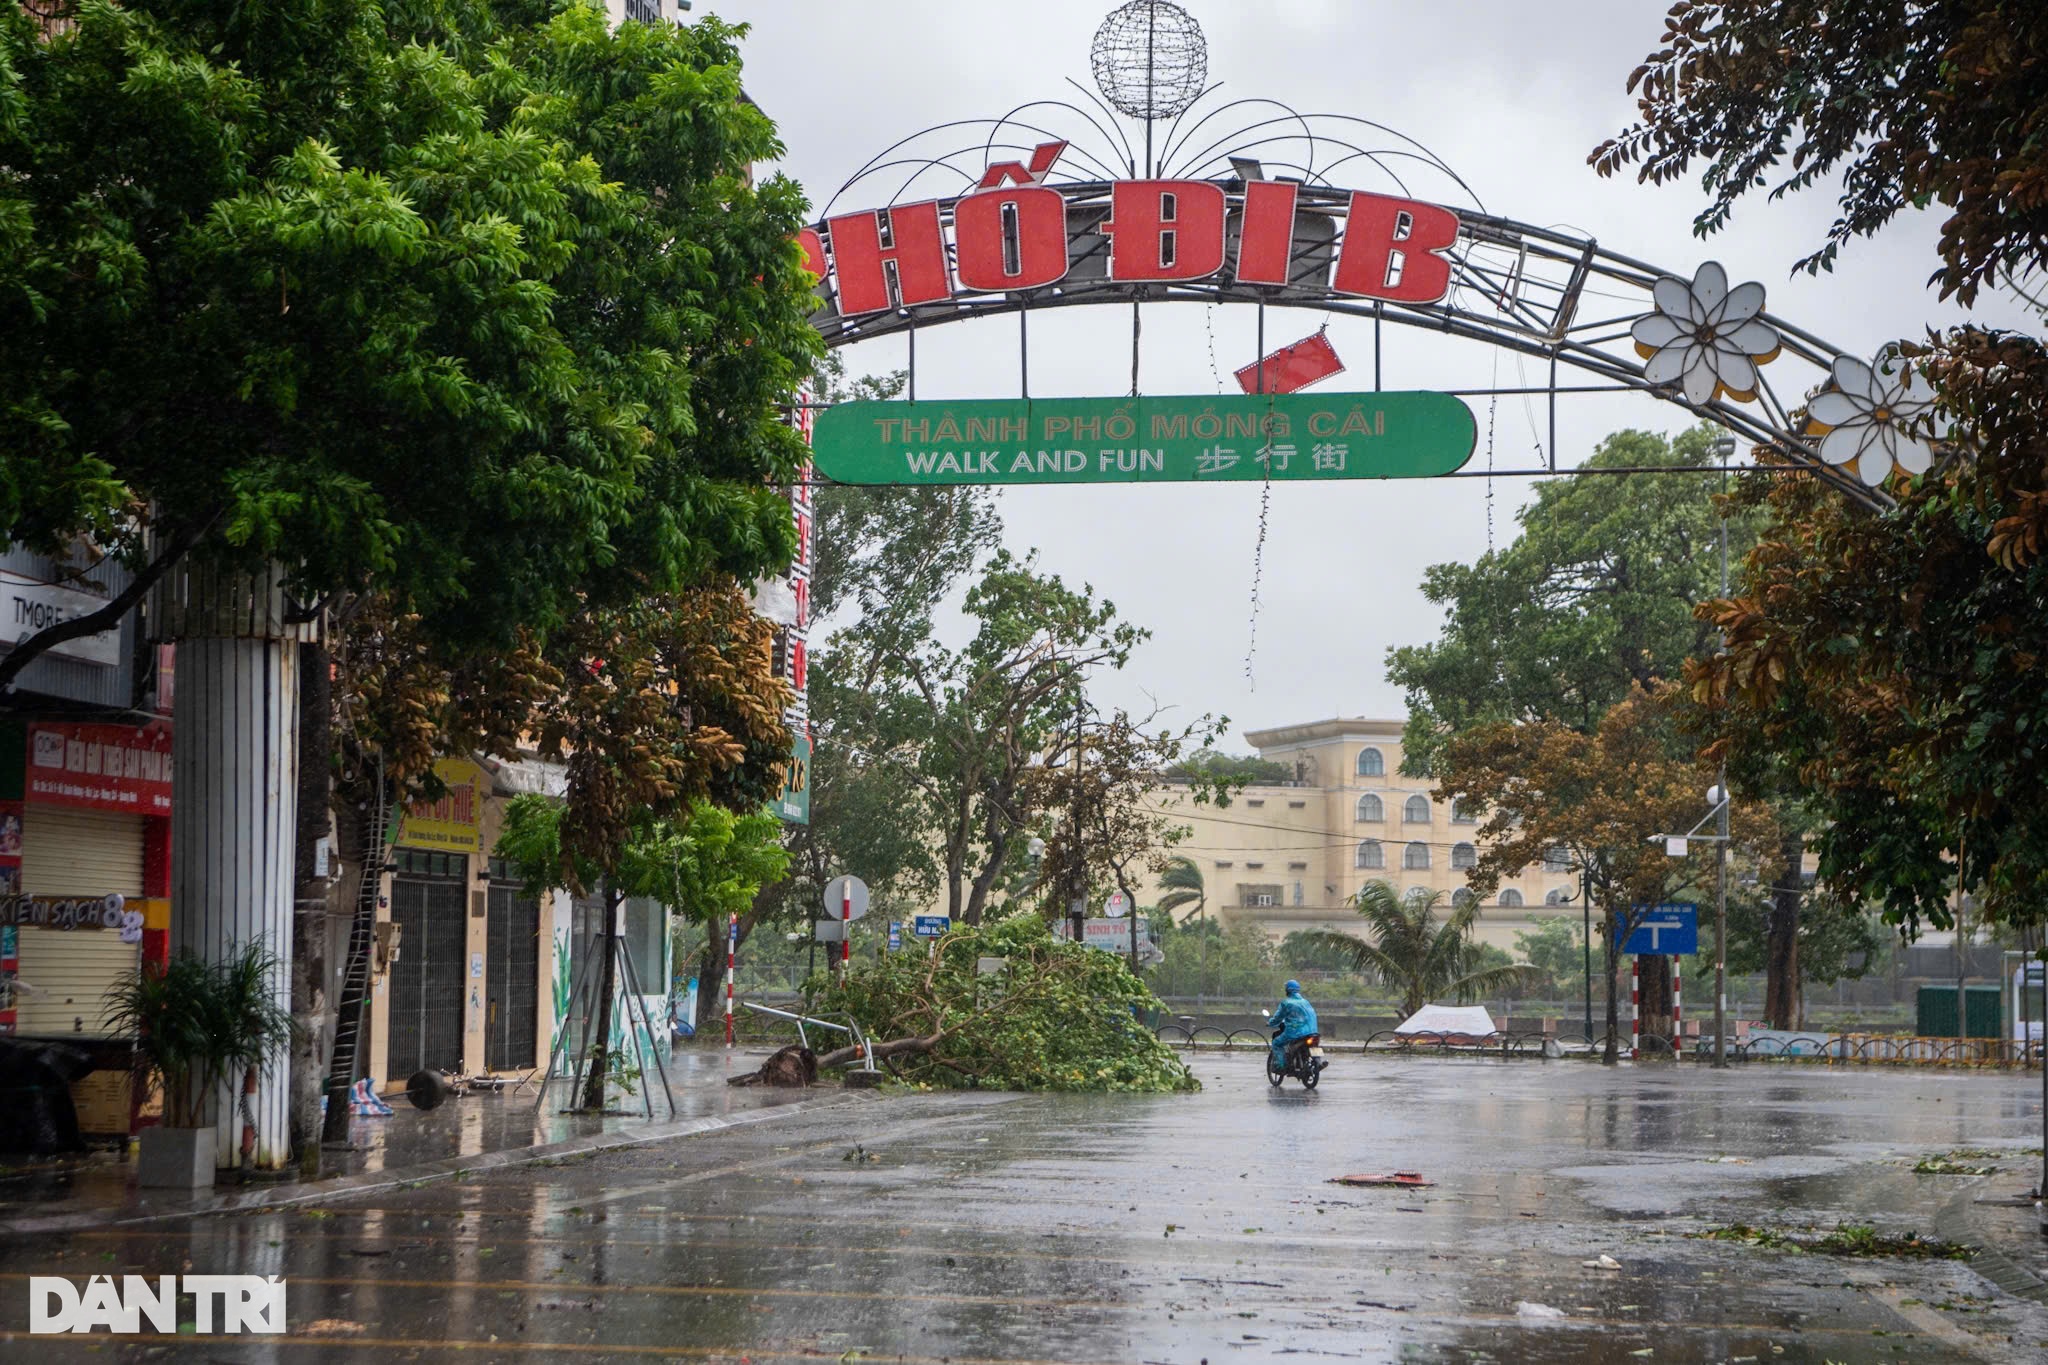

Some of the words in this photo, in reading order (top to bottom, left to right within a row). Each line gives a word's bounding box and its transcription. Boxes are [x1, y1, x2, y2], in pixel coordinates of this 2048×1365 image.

[1100, 178, 1298, 287] ĐI
[873, 410, 1028, 444] THÀNH
[1044, 402, 1136, 441] PHỐ
[1308, 402, 1385, 437] CÁI
[906, 451, 1000, 474] WALK
[1009, 450, 1087, 473] AND
[1099, 449, 1164, 472] FUN
[1195, 443, 1349, 473] 步行街
[1087, 924, 1111, 935] SINH
